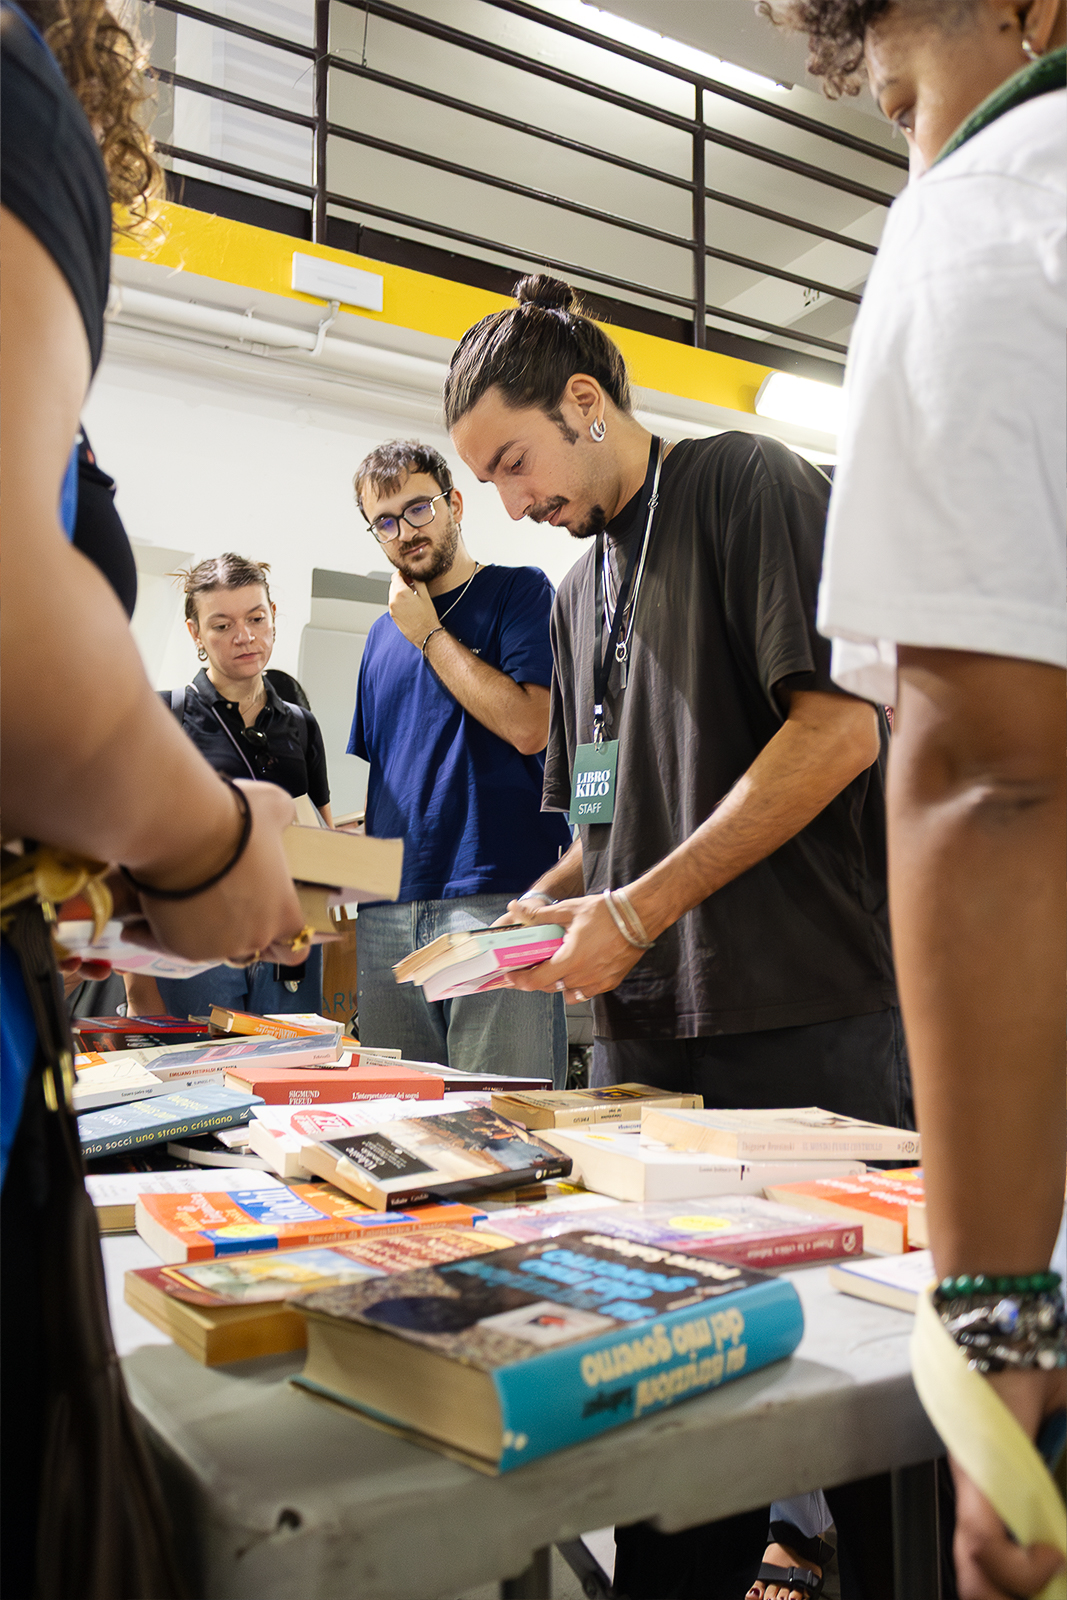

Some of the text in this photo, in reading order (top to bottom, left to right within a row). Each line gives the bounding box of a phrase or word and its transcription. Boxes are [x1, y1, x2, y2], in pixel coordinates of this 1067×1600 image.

[577, 769, 611, 784] LIBRO
[575, 782, 610, 798] KILO
[578, 803, 602, 815] STAFF
[288, 1090, 320, 1098] SIGMUND
[105, 1136, 133, 1151] socci
[135, 1132, 156, 1144] uno
[157, 1125, 189, 1139] strano
[190, 1114, 234, 1131] cristiano
[580, 1307, 745, 1387] del mio governo
